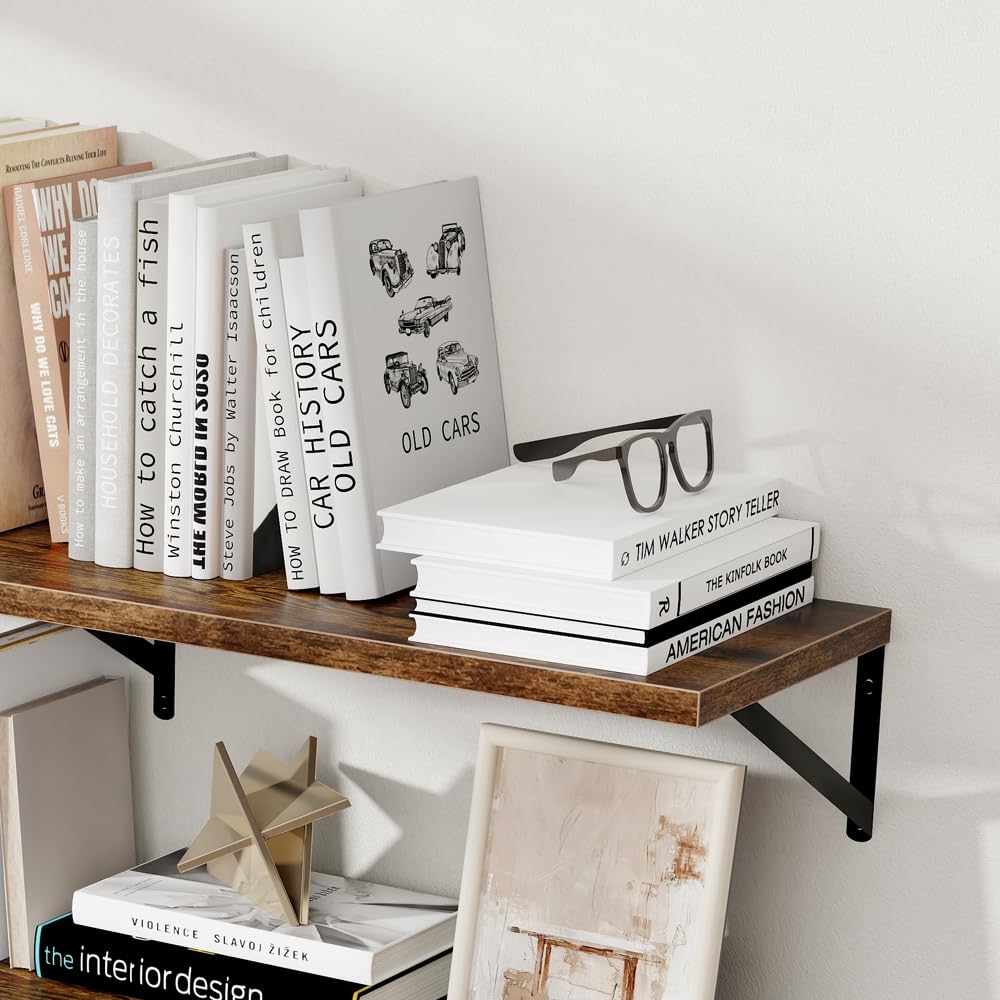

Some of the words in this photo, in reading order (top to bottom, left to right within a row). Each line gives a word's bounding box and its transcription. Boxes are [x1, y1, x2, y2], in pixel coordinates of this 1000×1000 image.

[41, 232, 69, 276] WE
[77, 230, 87, 270] house
[139, 220, 158, 287] fish
[76, 280, 87, 303] the
[103, 235, 120, 367] DECORATES
[227, 255, 238, 341] Isaacson
[252, 234, 272, 328] children
[31, 303, 43, 331] WHY
[77, 313, 87, 328] in
[142, 311, 157, 325] a
[35, 336, 46, 353] DO
[265, 345, 278, 376] for
[315, 320, 344, 404] CARS
[38, 357, 49, 377] WE
[77, 337, 90, 426] arrangement
[169, 324, 183, 446] Churchill
[226, 355, 236, 419] Walter
[41, 381, 54, 412] LOVE
[137, 347, 157, 433] catch
[290, 326, 325, 453] HISTORY
[46, 416, 59, 447] CATS
[269, 391, 286, 437] Book
[402, 426, 432, 454] OLD
[442, 411, 481, 442] CARS
[77, 435, 87, 451] an
[101, 380, 119, 510] HOUSEHOLD
[225, 432, 239, 452] by
[330, 430, 355, 492] OLD
[75, 458, 86, 492] make
[138, 452, 156, 484] to
[224, 466, 234, 506] Jobs
[277, 451, 293, 497] DRAW
[75, 500, 87, 513] to
[168, 464, 180, 557] Winston
[284, 511, 297, 531] TO
[310, 475, 334, 528] CAR
[75, 523, 86, 546] How
[136, 503, 155, 555] How
[223, 520, 233, 571] Steve
[636, 539, 655, 562] TIM
[659, 519, 705, 552] WALKER
[707, 503, 743, 533] STORY
[745, 490, 780, 518] TELLER
[289, 545, 304, 581] HOW
[706, 578, 723, 592] THE
[726, 559, 762, 585] KINFOLK
[764, 548, 788, 568] BOOK
[666, 613, 743, 663] AMERICAN
[746, 586, 806, 627] FASHION
[44, 945, 74, 971] the
[131, 917, 199, 940] VIOLENCE
[213, 933, 263, 953] SLAVOJ
[268, 943, 309, 962] ŽIŽEK
